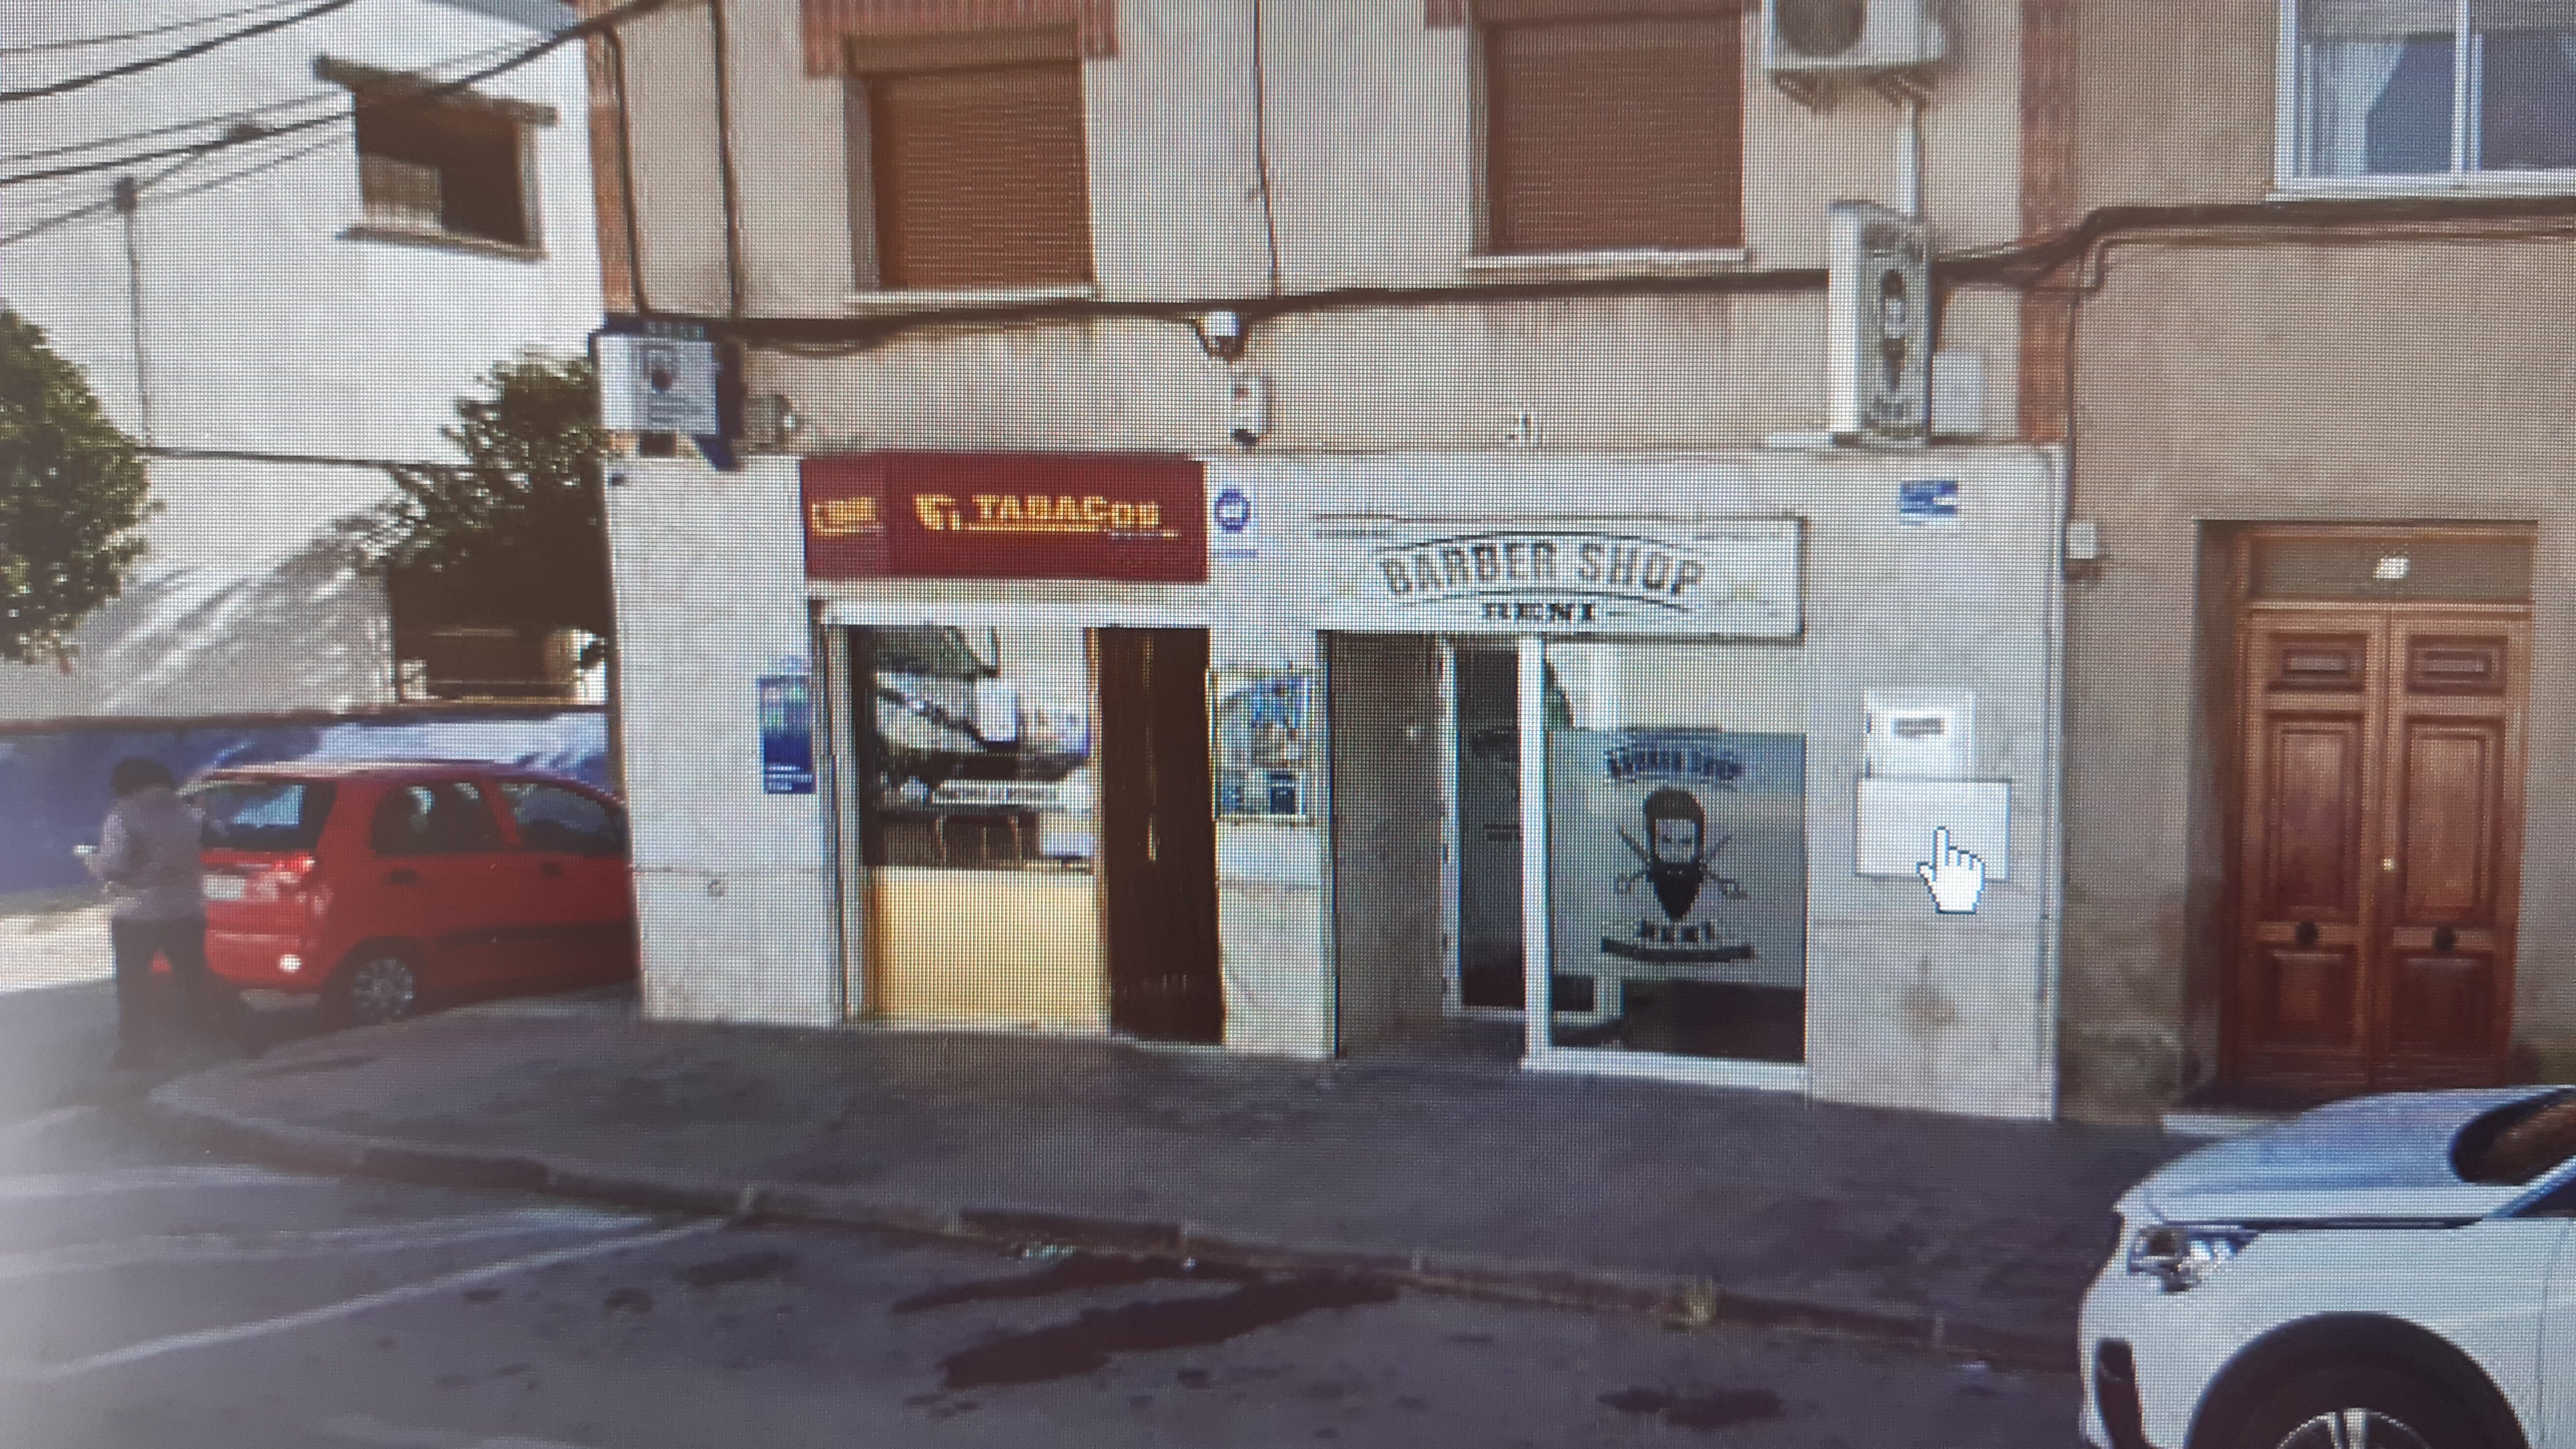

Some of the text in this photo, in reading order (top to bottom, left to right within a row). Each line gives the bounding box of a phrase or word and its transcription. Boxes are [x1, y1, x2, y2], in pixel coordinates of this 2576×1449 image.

[1380, 542, 1705, 596] BARBER SHOP
[1483, 603, 1597, 622] RENI
